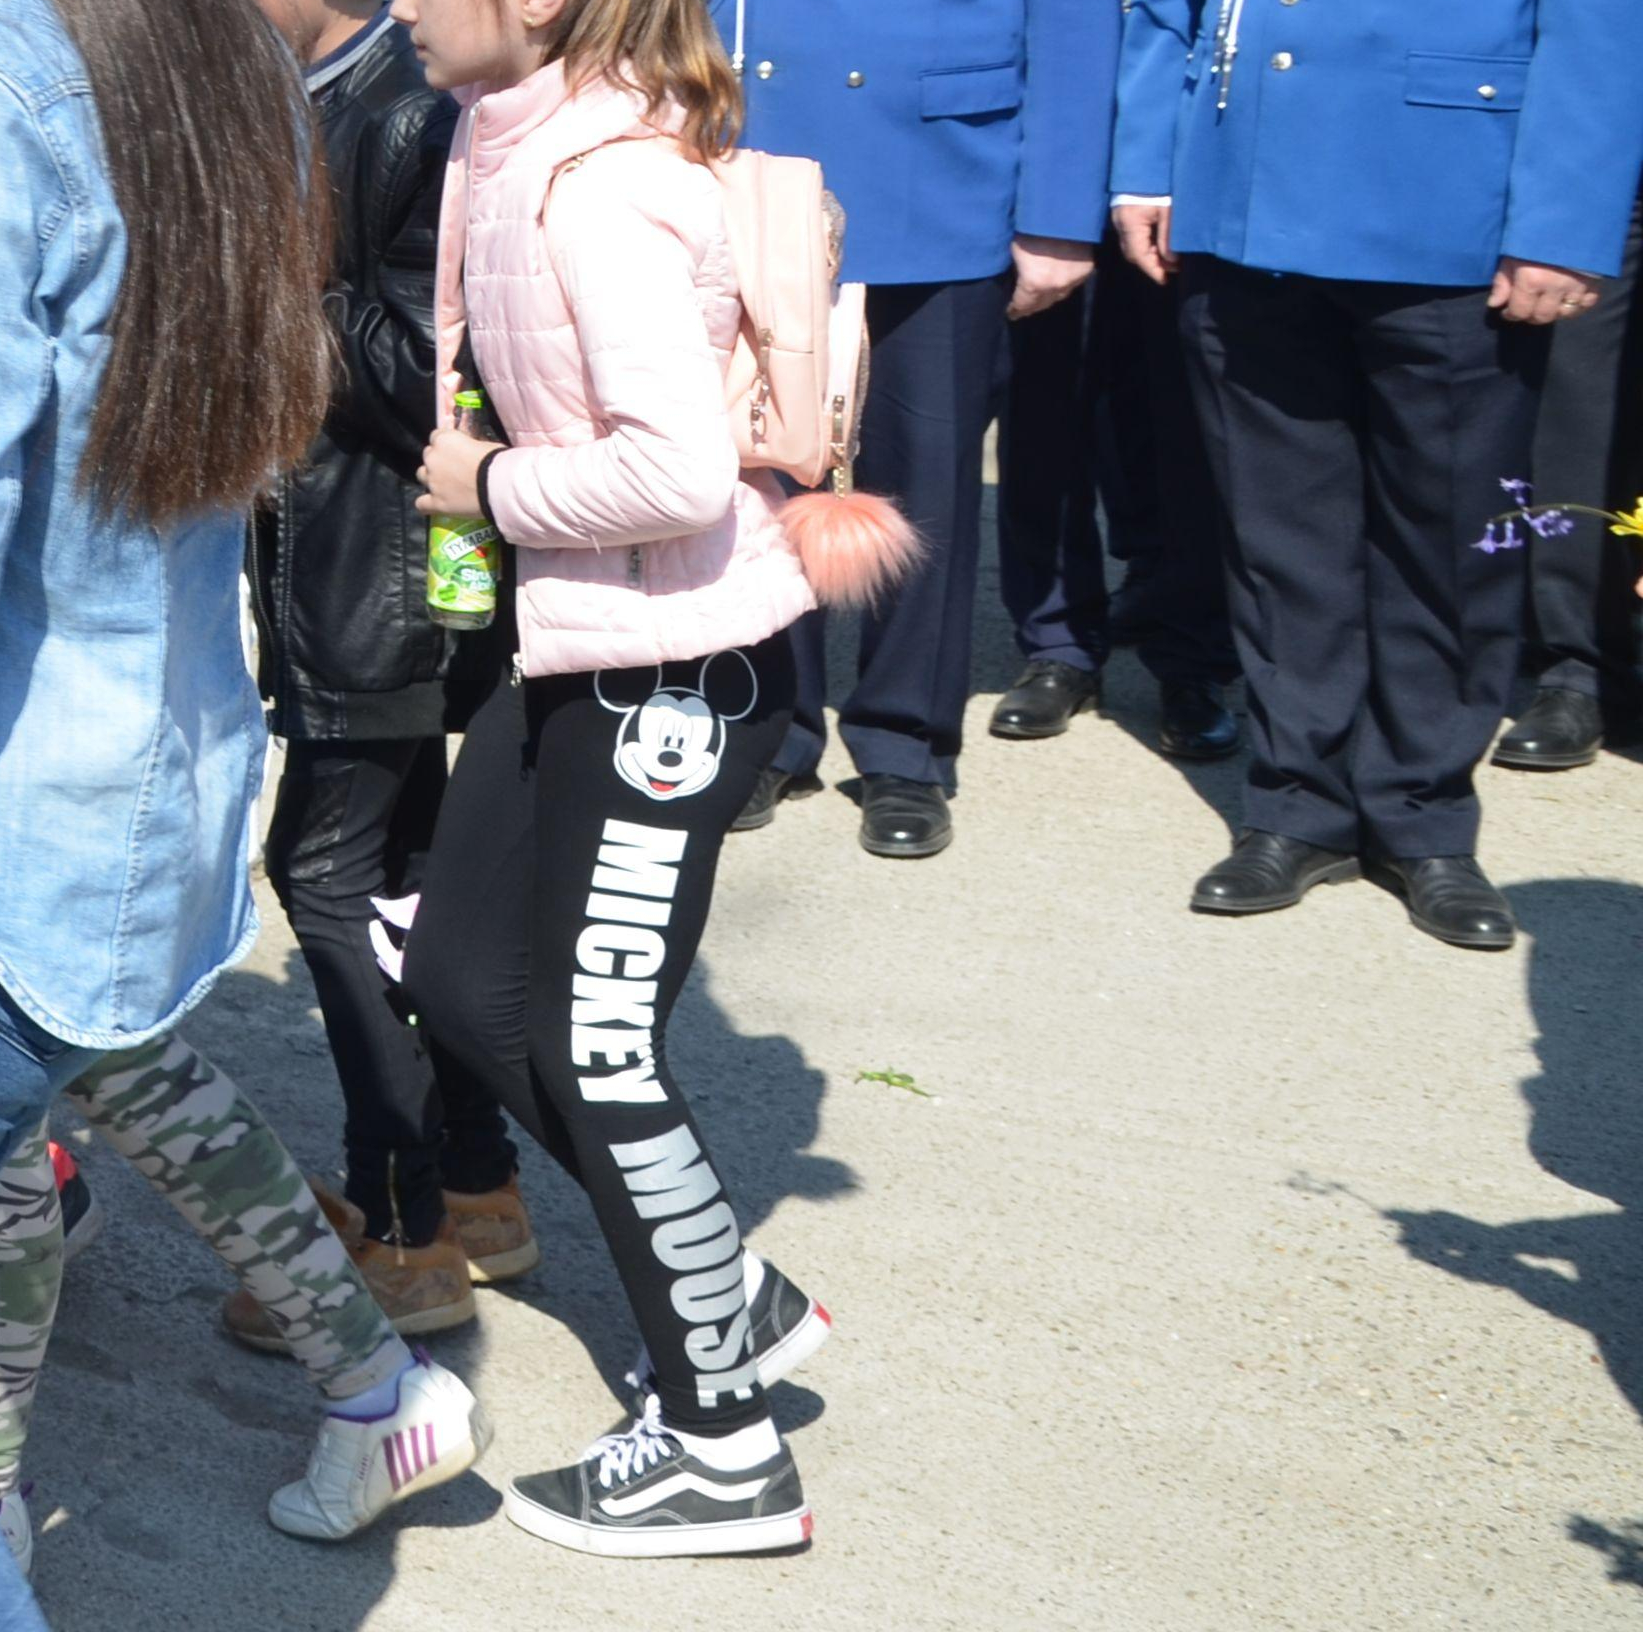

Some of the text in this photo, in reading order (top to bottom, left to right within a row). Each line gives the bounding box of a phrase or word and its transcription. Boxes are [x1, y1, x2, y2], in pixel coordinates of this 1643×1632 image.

[448, 527, 498, 556] TYMBA
[569, 818, 688, 1104] MICKEY
[608, 1123, 762, 1408] MOUSE
